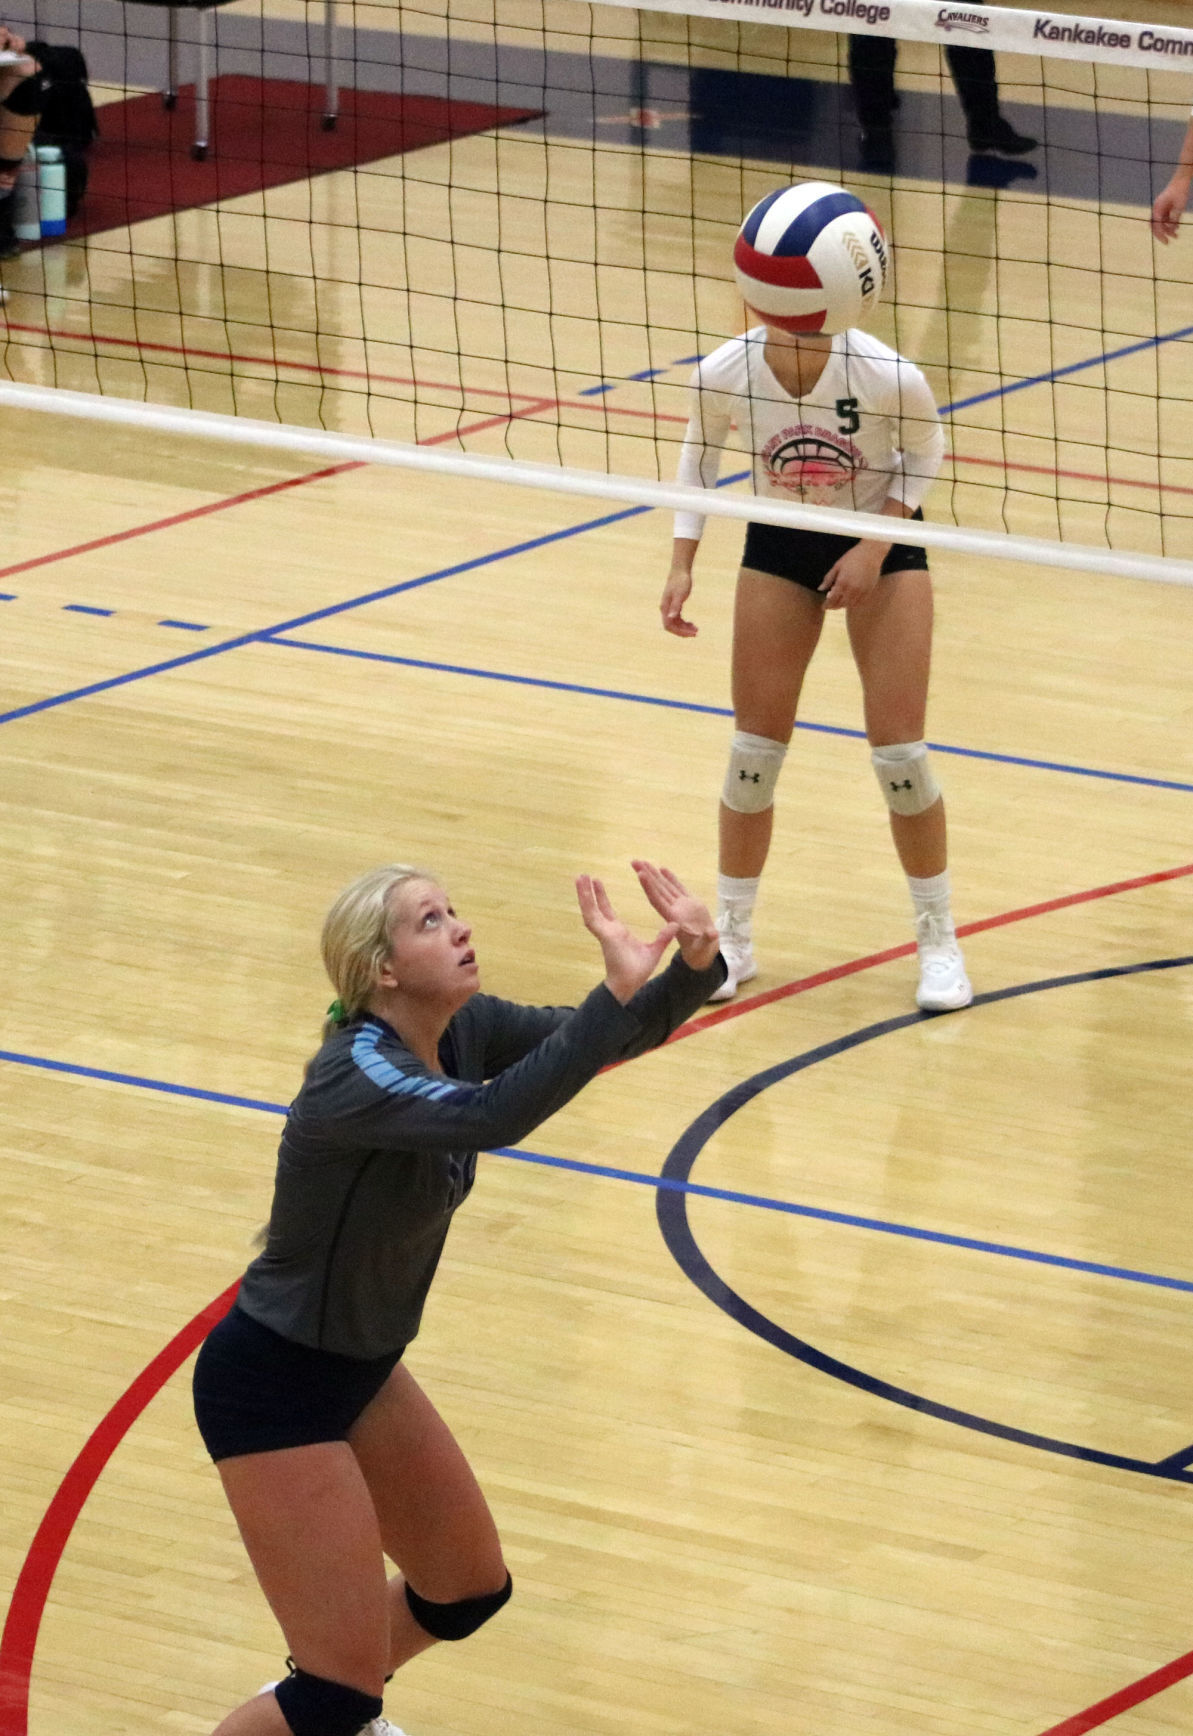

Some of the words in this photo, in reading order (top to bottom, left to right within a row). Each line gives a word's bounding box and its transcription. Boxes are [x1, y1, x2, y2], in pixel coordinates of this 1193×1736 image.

[820, 0, 891, 24] College
[937, 8, 990, 27] CAVALIERS
[1033, 18, 1132, 48] Kankakee
[836, 397, 861, 435] 5
